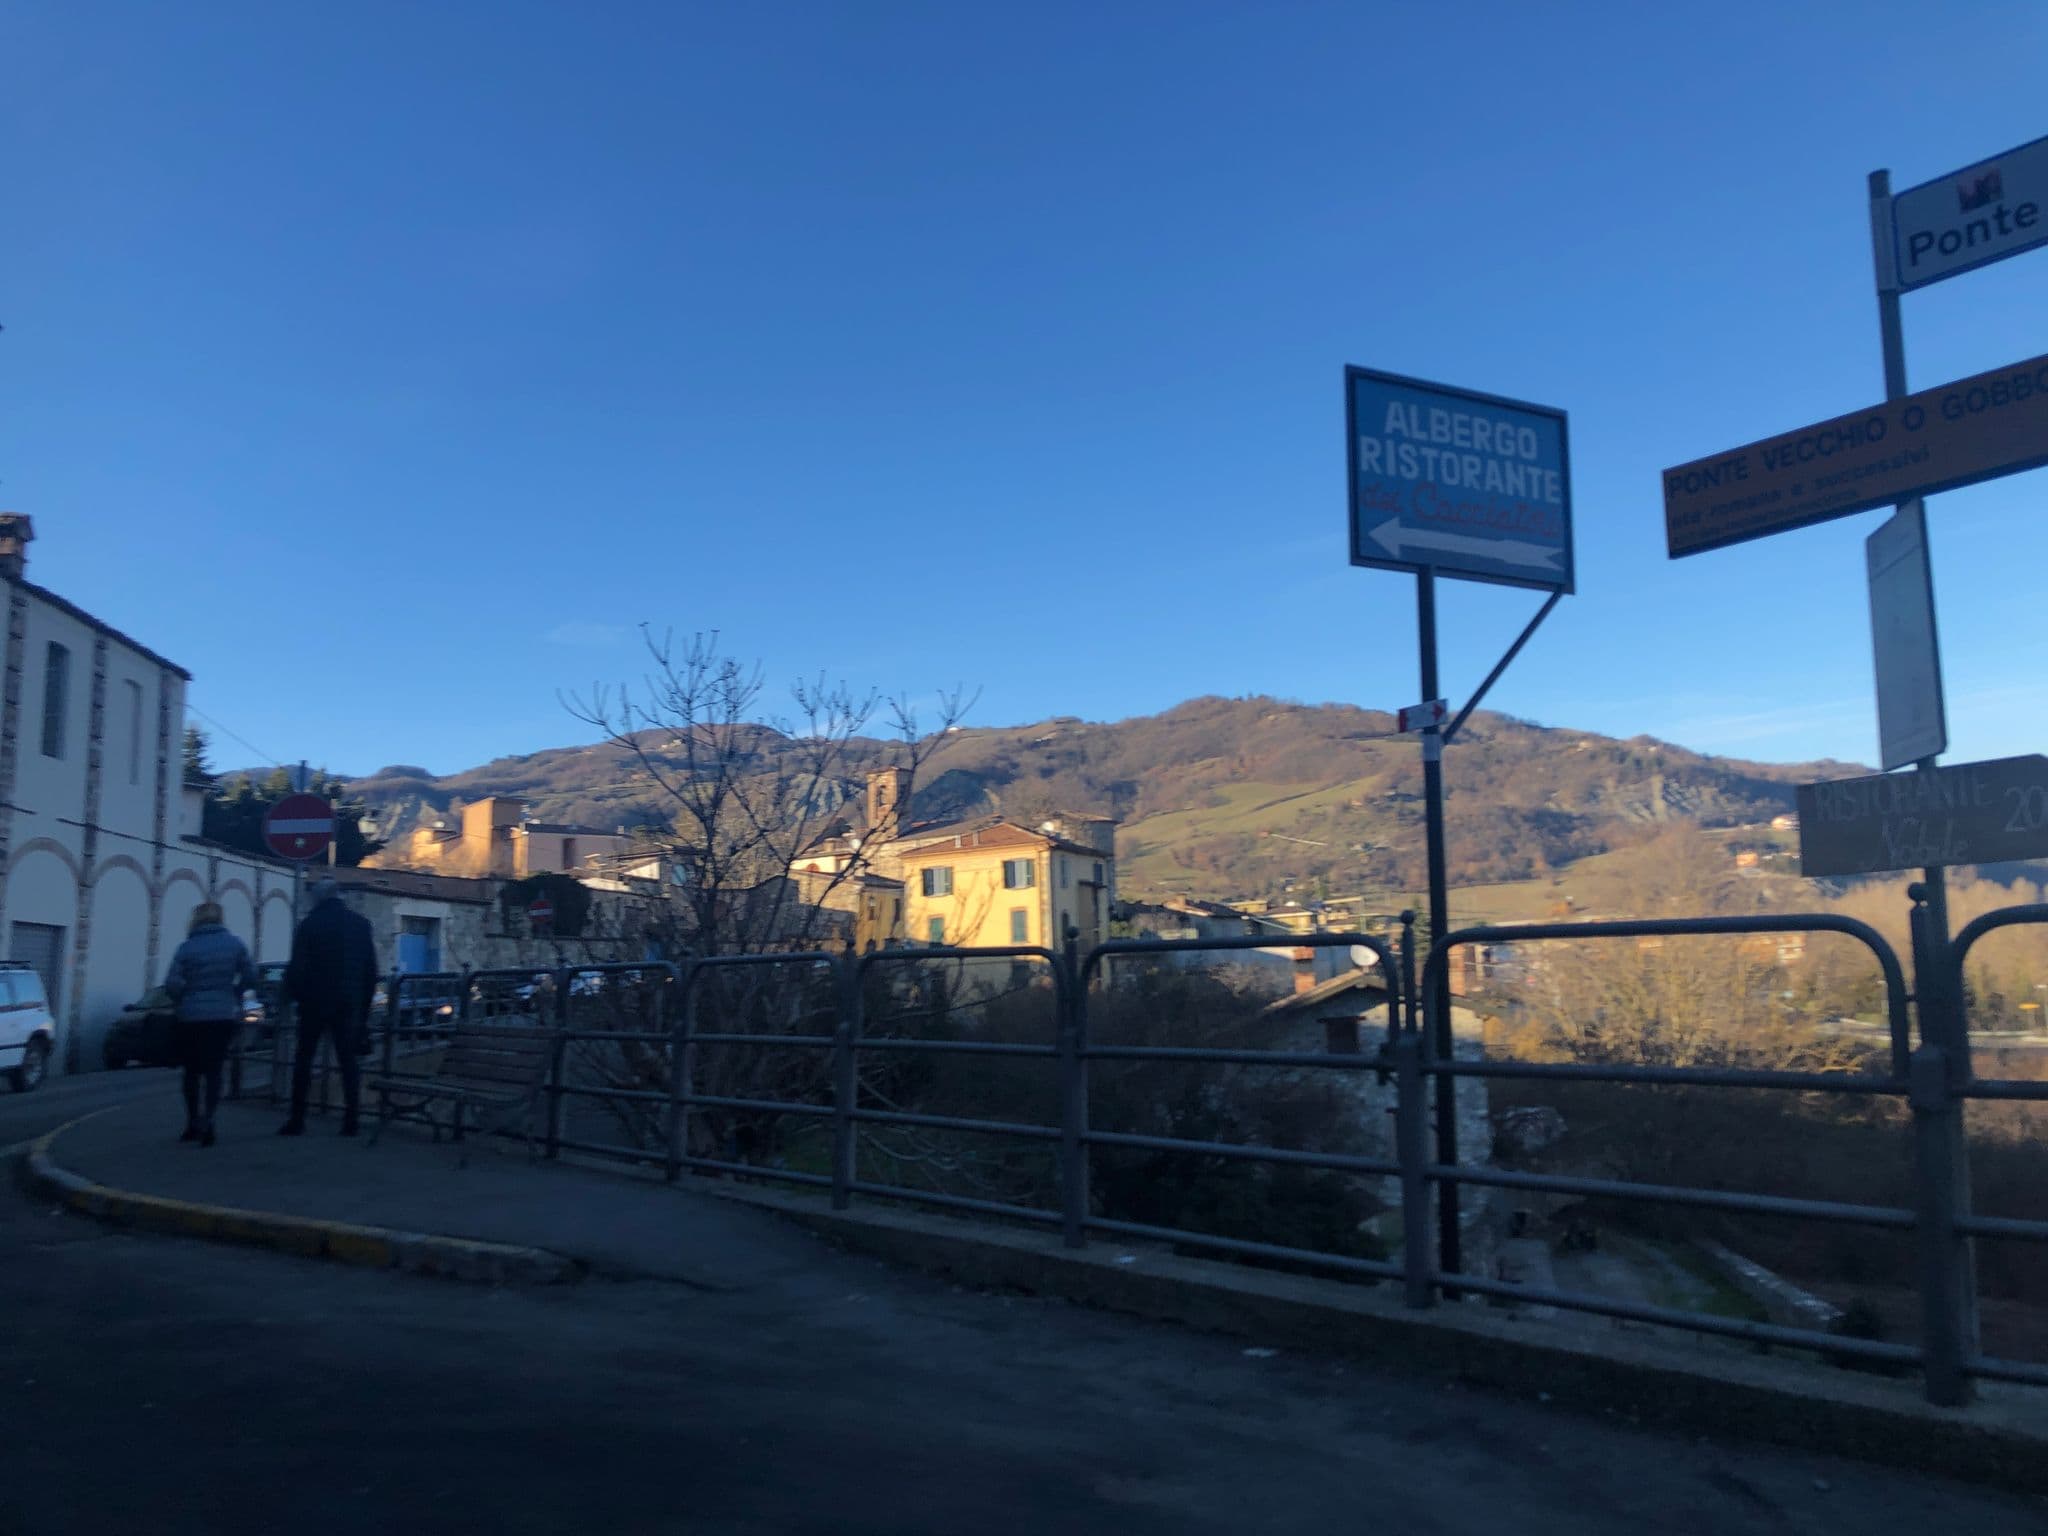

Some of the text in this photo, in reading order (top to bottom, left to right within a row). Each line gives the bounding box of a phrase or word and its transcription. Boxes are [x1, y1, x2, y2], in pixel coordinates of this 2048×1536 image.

[1909, 201, 2039, 267] Ponte
[1384, 400, 1538, 461] ALBERGO
[1668, 457, 1750, 499] PONTE
[1761, 416, 1887, 472] VECCHIO
[1903, 405, 1926, 433] O
[1359, 434, 1562, 505] RISTORANTE
